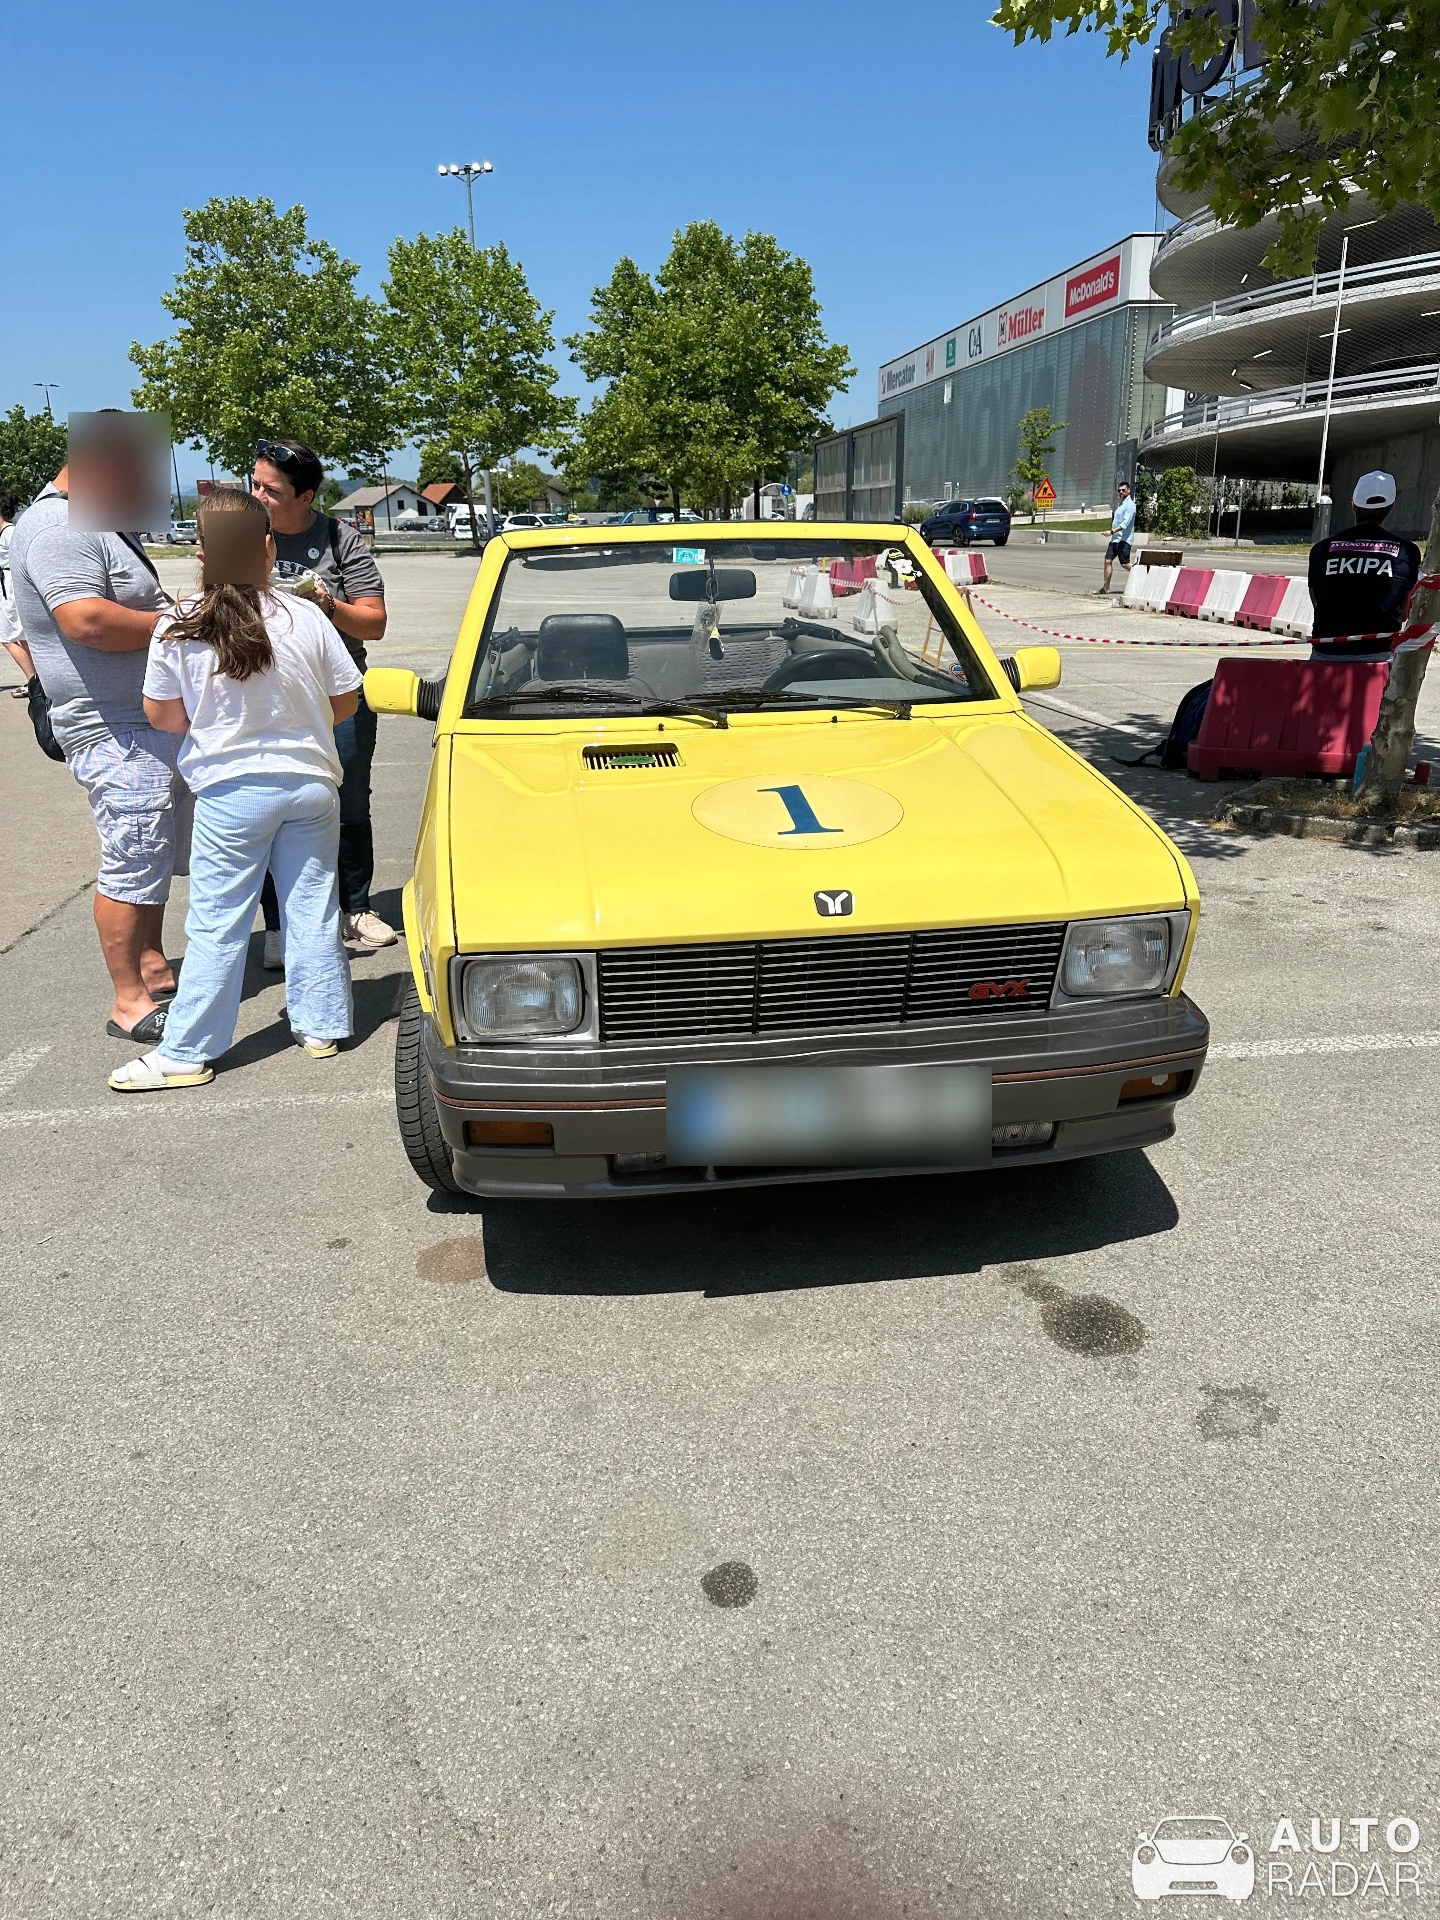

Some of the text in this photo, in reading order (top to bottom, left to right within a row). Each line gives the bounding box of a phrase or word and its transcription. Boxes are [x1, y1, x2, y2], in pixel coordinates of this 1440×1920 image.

[1069, 270, 1115, 306] McDonald's
[1008, 306, 1045, 342] Müller
[968, 325, 982, 358] C&A
[886, 363, 915, 392] Mercator
[1325, 557, 1393, 577] EKIPA
[757, 785, 844, 835] 1
[968, 979, 1031, 1000] GVX
